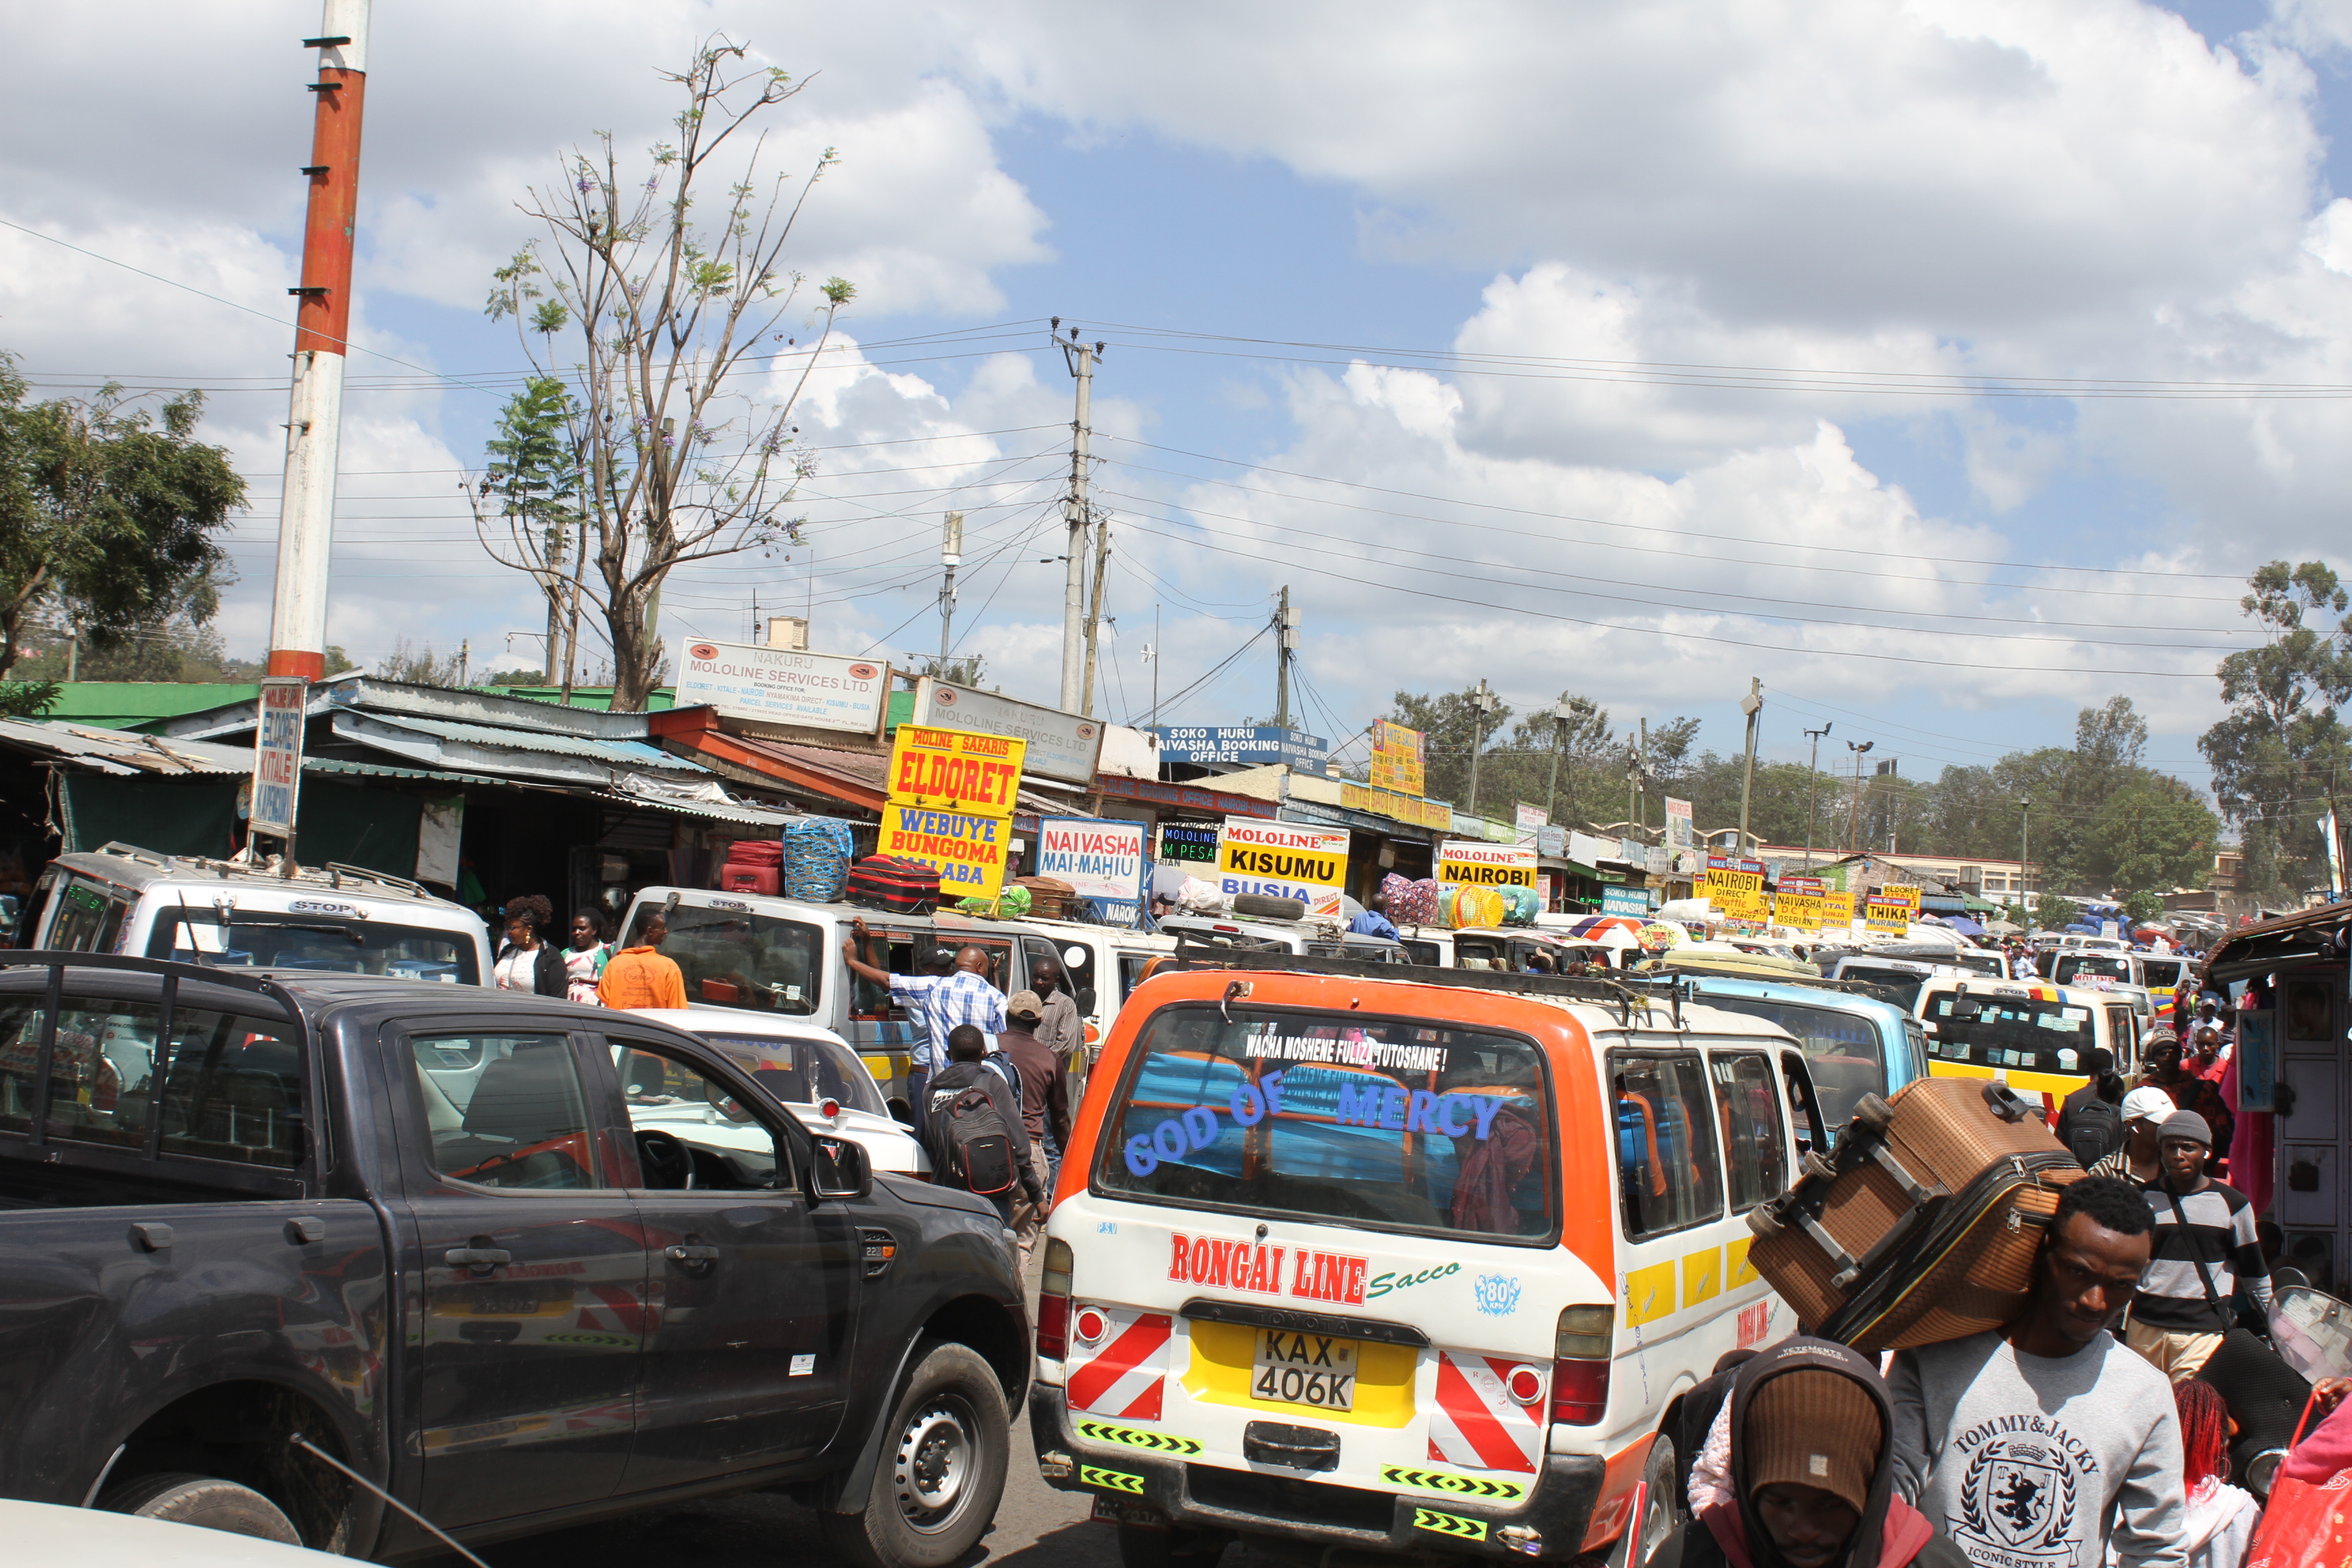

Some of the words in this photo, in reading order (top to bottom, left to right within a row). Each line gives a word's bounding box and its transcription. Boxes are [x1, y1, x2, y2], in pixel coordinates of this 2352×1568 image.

[754, 651, 813, 669] NAKURU
[690, 660, 764, 679] MOLOLINE
[768, 670, 839, 688] SERVICES
[843, 680, 872, 693] LTD.
[686, 681, 712, 690] ELDORET
[717, 685, 736, 693] KITALE
[740, 688, 764, 698] NAIROBI
[766, 691, 800, 702] NYAMAKIMA
[826, 699, 848, 708] KISUMU
[853, 702, 870, 710] BUSIA
[740, 698, 762, 706] PARCEL
[765, 700, 793, 710] SERVICES
[796, 705, 827, 715] AVAILABLE
[995, 705, 1044, 725] NAKURU
[935, 708, 1002, 732] MOLOLINE
[1005, 724, 1063, 747] SERVICES
[1066, 739, 1089, 753] LTD.
[1170, 728, 1207, 738] SOKO
[1218, 729, 1254, 739] HURU
[1290, 732, 1302, 743] SOKO
[1305, 734, 1317, 747] HURU
[913, 730, 954, 748] MOLINE
[962, 736, 1009, 755] SAFARIS
[1032, 748, 1046, 757] DIRECT
[1158, 740, 1216, 751] AIVASHA
[1221, 740, 1279, 751] BOOKING
[1281, 742, 1307, 757] NAIVASHA
[1308, 750, 1327, 761] BOOKING
[1190, 751, 1239, 762] OFFICE
[1295, 757, 1313, 770] OFFICE
[259, 751, 291, 784] KITALE
[897, 751, 1015, 805] ELDORET
[1139, 784, 1178, 801] BOOKING
[1183, 790, 1213, 806] OFFICE
[1284, 799, 1343, 820] NAIVASHA
[1371, 791, 1393, 811] SACCO
[1399, 798, 1422, 817] BOOKING
[1426, 806, 1447, 822] OFFICE
[900, 808, 997, 843] WEBUYE
[1045, 831, 1140, 856] NAIVASHA
[1166, 830, 1216, 844] MOLOLINE
[1228, 827, 1321, 849] MOLOLINE
[890, 831, 998, 864] BUNGOMA
[1164, 844, 1173, 856] M
[1181, 845, 1214, 860] PESA
[1443, 849, 1516, 864] MOLOLINE
[1230, 849, 1335, 881] KISUMU
[1446, 865, 1530, 886] NAIROBI
[1707, 871, 1758, 892] NAIROBI
[1222, 878, 1311, 904] BUSIA
[1313, 892, 1338, 906] DIRECT
[1605, 888, 1626, 897] SOKO
[1628, 891, 1648, 900] HURU
[1716, 888, 1747, 898] DIRECT
[1884, 886, 1919, 894] ELDORET
[295, 901, 351, 912] STOP
[713, 900, 746, 909] STOP
[1603, 899, 1648, 915] NAIVASHA
[1713, 896, 1746, 908] Shuttle
[1778, 896, 1821, 909] NAIVASHA
[1106, 903, 1137, 923] NAROK
[1778, 915, 1812, 926] OSERIAN
[1869, 906, 1907, 920] THIKA
[1867, 918, 1906, 929] MURANGA
[1893, 962, 1916, 970] STOP
[1246, 1034, 1281, 1058] WACHA
[1284, 1037, 1335, 1062] MOSHENE
[1124, 1106, 1218, 1177] GOD
[1230, 1069, 1285, 1126] OF
[1336, 1082, 1503, 1140] MERCY
[1097, 1222, 1117, 1235] P.S.V
[1167, 1232, 1286, 1296] RONGAI
[1290, 1247, 1369, 1307] LINE
[1366, 1262, 1462, 1298] Sacco
[1487, 1281, 1508, 1303] 80
[1254, 1309, 1350, 1335] TOYOTA
[1266, 1330, 1333, 1368] KAX
[1782, 1345, 1843, 1357] VETEMENTS
[1256, 1366, 1352, 1407] 406K
[1997, 1465, 2009, 1480] T
[2040, 1473, 2051, 1489] J
[1967, 1546, 2012, 1567] ICONIC
[2014, 1559, 2056, 1568] STYLE
